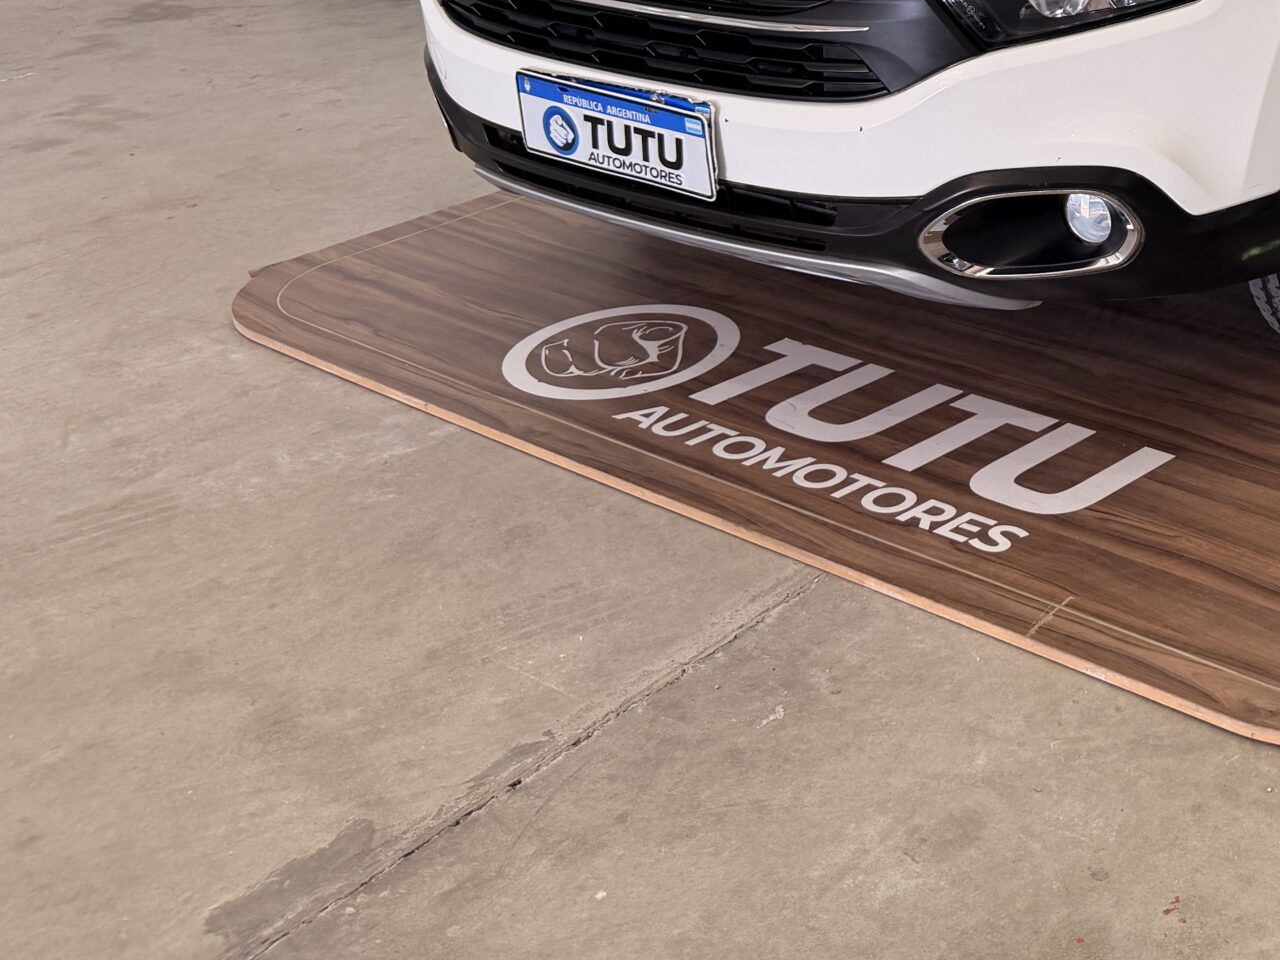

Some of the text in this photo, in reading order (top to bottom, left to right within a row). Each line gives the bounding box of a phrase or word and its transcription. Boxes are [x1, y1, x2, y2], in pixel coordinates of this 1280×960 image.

[563, 94, 651, 123] REPÚBLICA ARGENTINA
[583, 114, 683, 170] TUTU
[588, 151, 683, 186] AUTOMOTORES
[688, 336, 1176, 515] TUTU
[612, 405, 1030, 554] AUTOMOTORES
